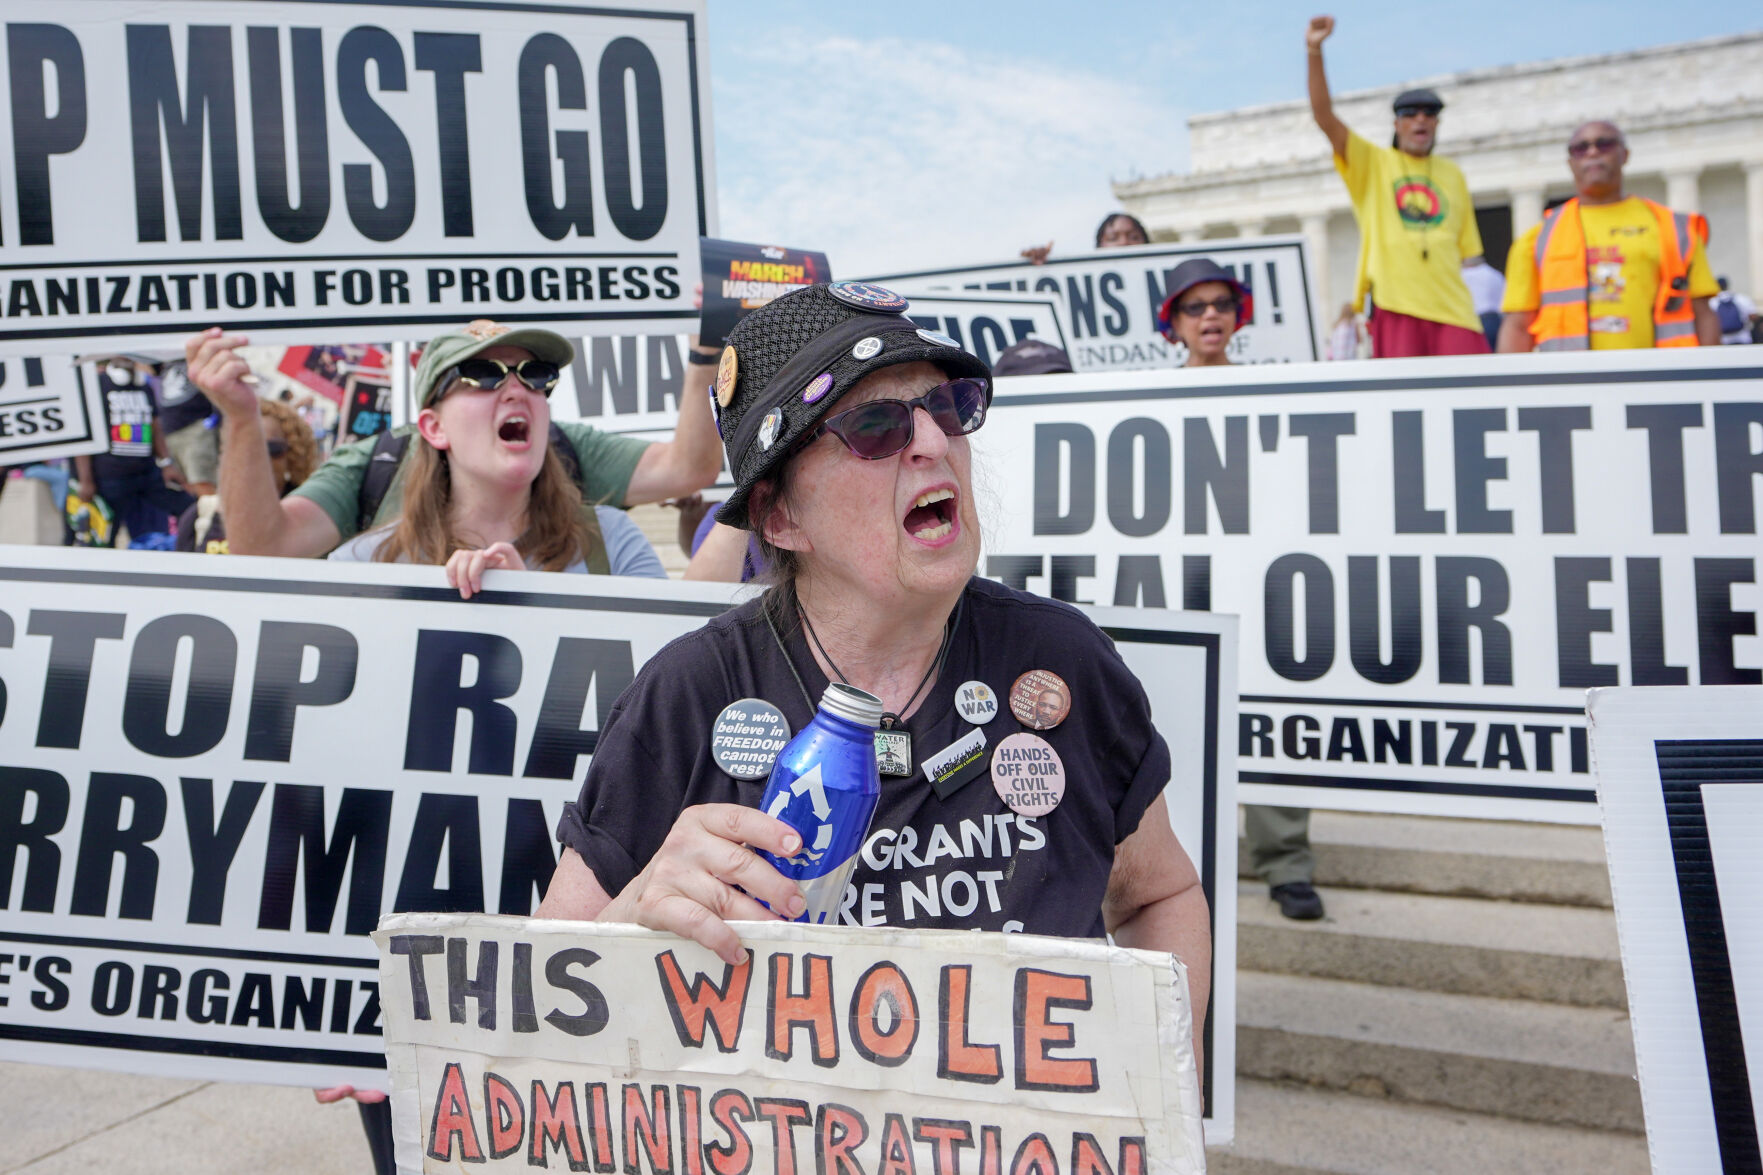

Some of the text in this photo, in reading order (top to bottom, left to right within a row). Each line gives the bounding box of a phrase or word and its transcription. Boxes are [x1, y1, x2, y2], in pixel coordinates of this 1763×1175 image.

[0, 22, 669, 247] P MUST GO
[730, 260, 804, 281] MARCH
[0, 265, 681, 318] ANIZATION FOR PROGRESS
[1034, 412, 1357, 536] DON'T
[1392, 406, 1592, 534] LET
[1264, 552, 1513, 687] OUR
[0, 607, 359, 764] TOP
[1029, 674, 1060, 691] ANYWHERE
[961, 700, 996, 716] WAR
[1013, 700, 1031, 711] EVERY
[1014, 695, 1037, 707] JUSTICE
[725, 710, 779, 723] We who
[1014, 708, 1033, 719] WHERE
[716, 721, 784, 737] believe in
[713, 735, 786, 751] FREEDOM
[719, 750, 776, 764] cannot
[1000, 747, 1051, 762] HANDS
[728, 763, 764, 775] rest
[996, 762, 1059, 777] OFF OUR
[1011, 777, 1049, 792] CIVIL
[1005, 791, 1059, 807] RIGHTS
[853, 812, 1046, 872] GRANTS
[900, 870, 1004, 921] NOT
[389, 934, 1099, 1093] THIS WHOLE
